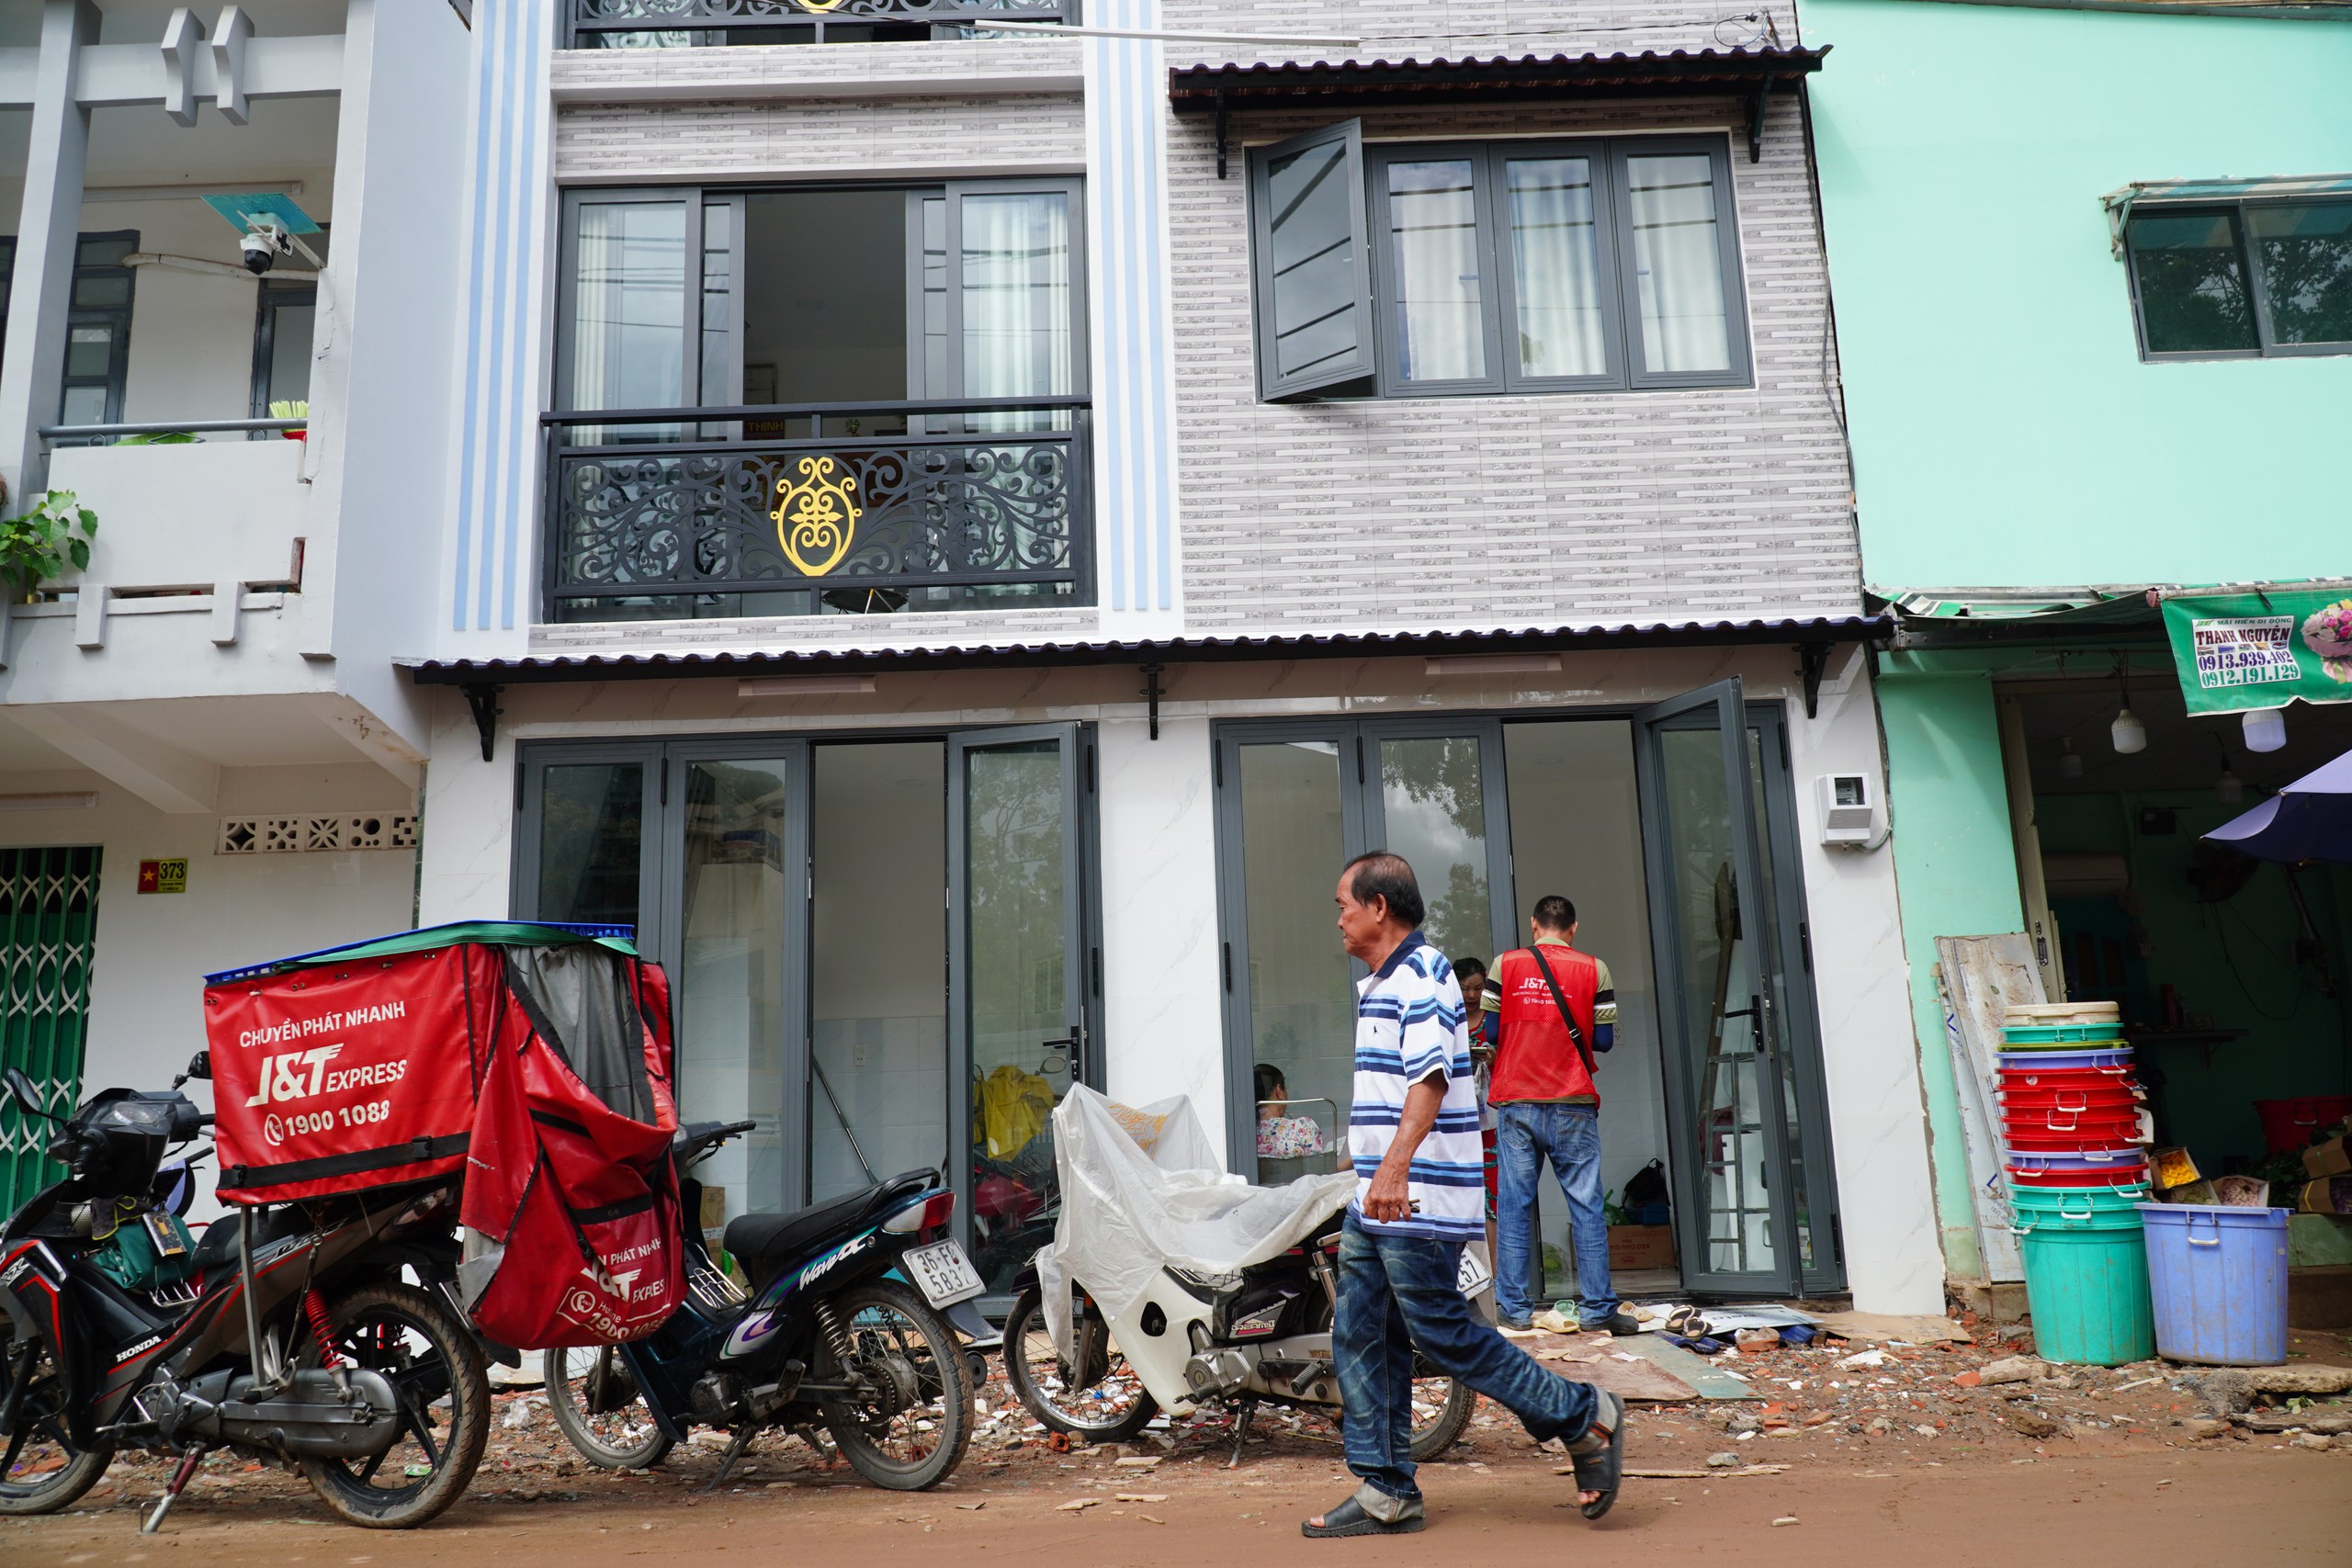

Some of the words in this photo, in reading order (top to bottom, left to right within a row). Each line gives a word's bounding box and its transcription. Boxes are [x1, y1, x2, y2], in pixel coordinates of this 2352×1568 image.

[2196, 630, 2238, 645] THANH
[2199, 651, 2293, 671] 0913.939.402
[2201, 665, 2299, 686] 0912.191.129
[160, 863, 185, 879] 373
[1519, 977, 1546, 989] J&T
[303, 1011, 343, 1036] PHÁT
[345, 1001, 405, 1027] NHANH
[244, 1043, 345, 1107] J&T
[326, 1059, 407, 1093] EXPRESS
[286, 1111, 334, 1136] 1900
[339, 1100, 390, 1127] 1088
[1231, 1322, 1268, 1331] DREAM
[116, 1335, 162, 1362] HONDA
